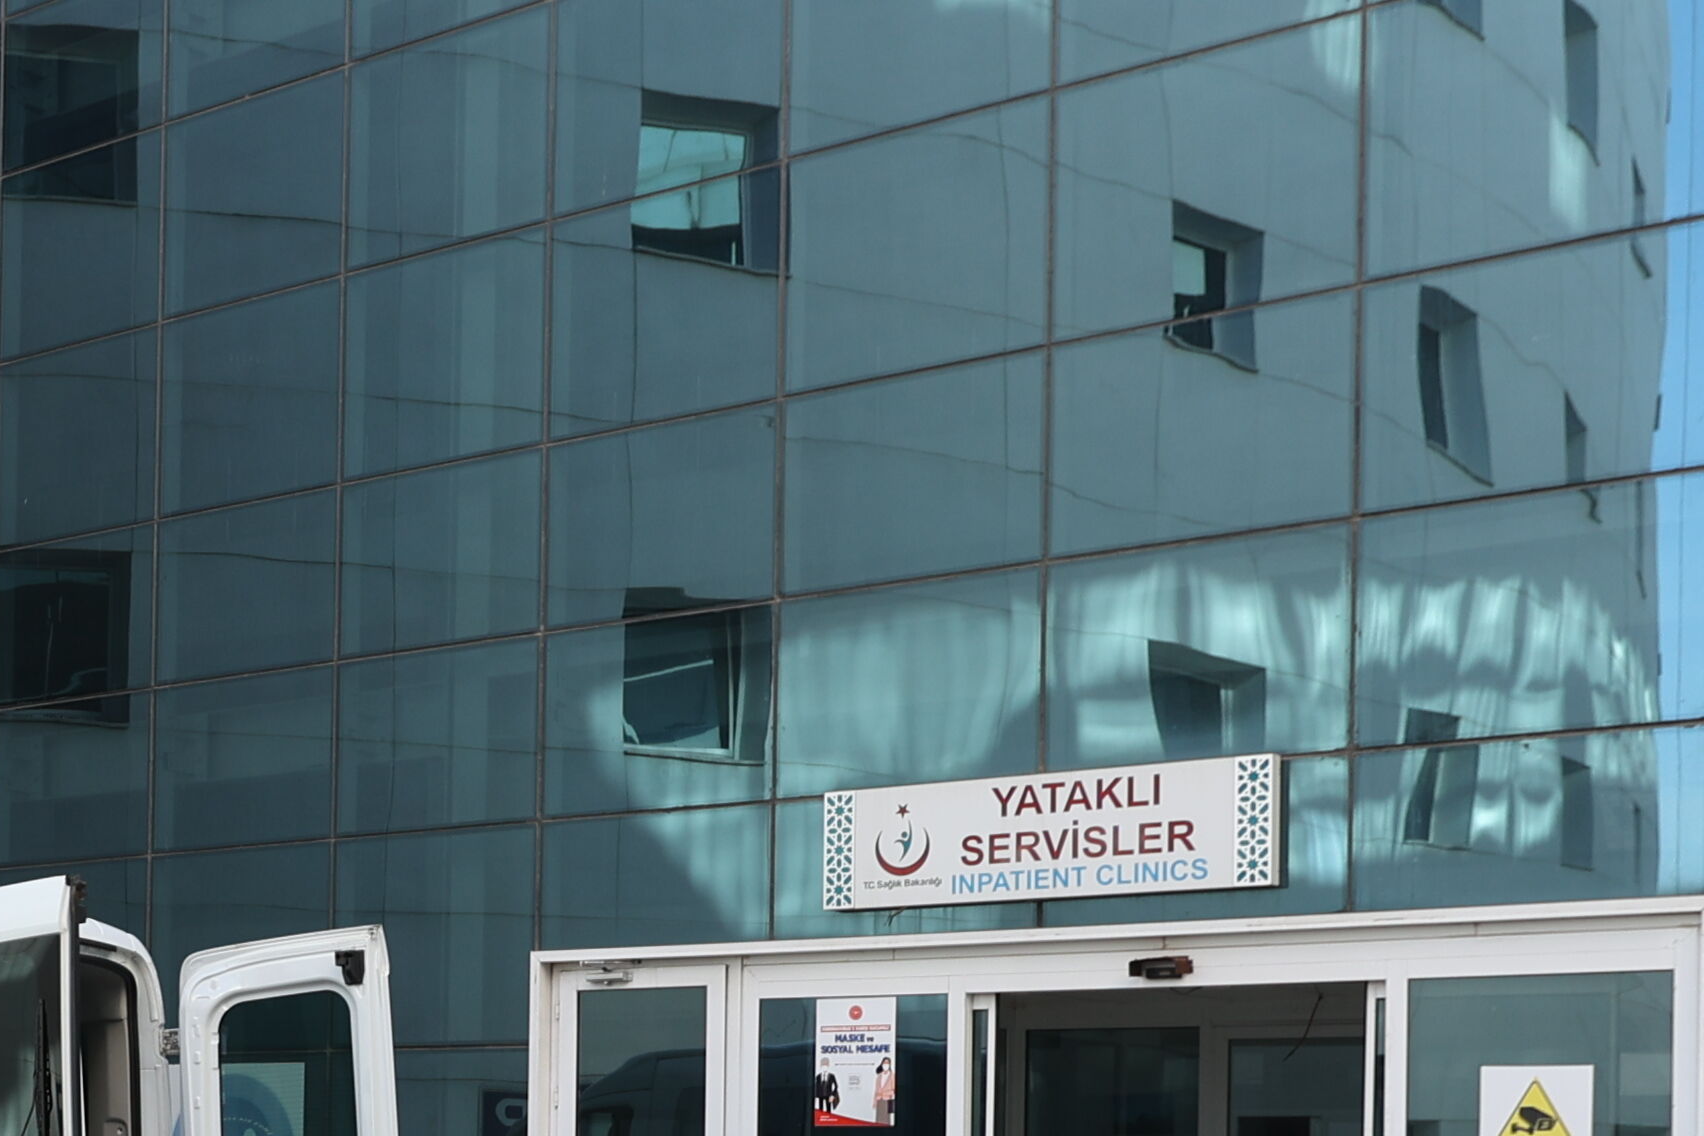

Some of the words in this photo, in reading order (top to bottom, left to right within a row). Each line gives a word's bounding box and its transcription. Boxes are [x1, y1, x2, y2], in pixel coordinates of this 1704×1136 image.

[992, 773, 1161, 818] YATAKLI
[960, 819, 1196, 866] SERVİSLER
[951, 866, 1088, 895] INPATIENT
[1095, 858, 1209, 886] CLINICS
[821, 1045, 854, 1054] SOSYAL
[856, 1044, 891, 1053] MESAFE
[835, 1033, 866, 1043] MASKE
